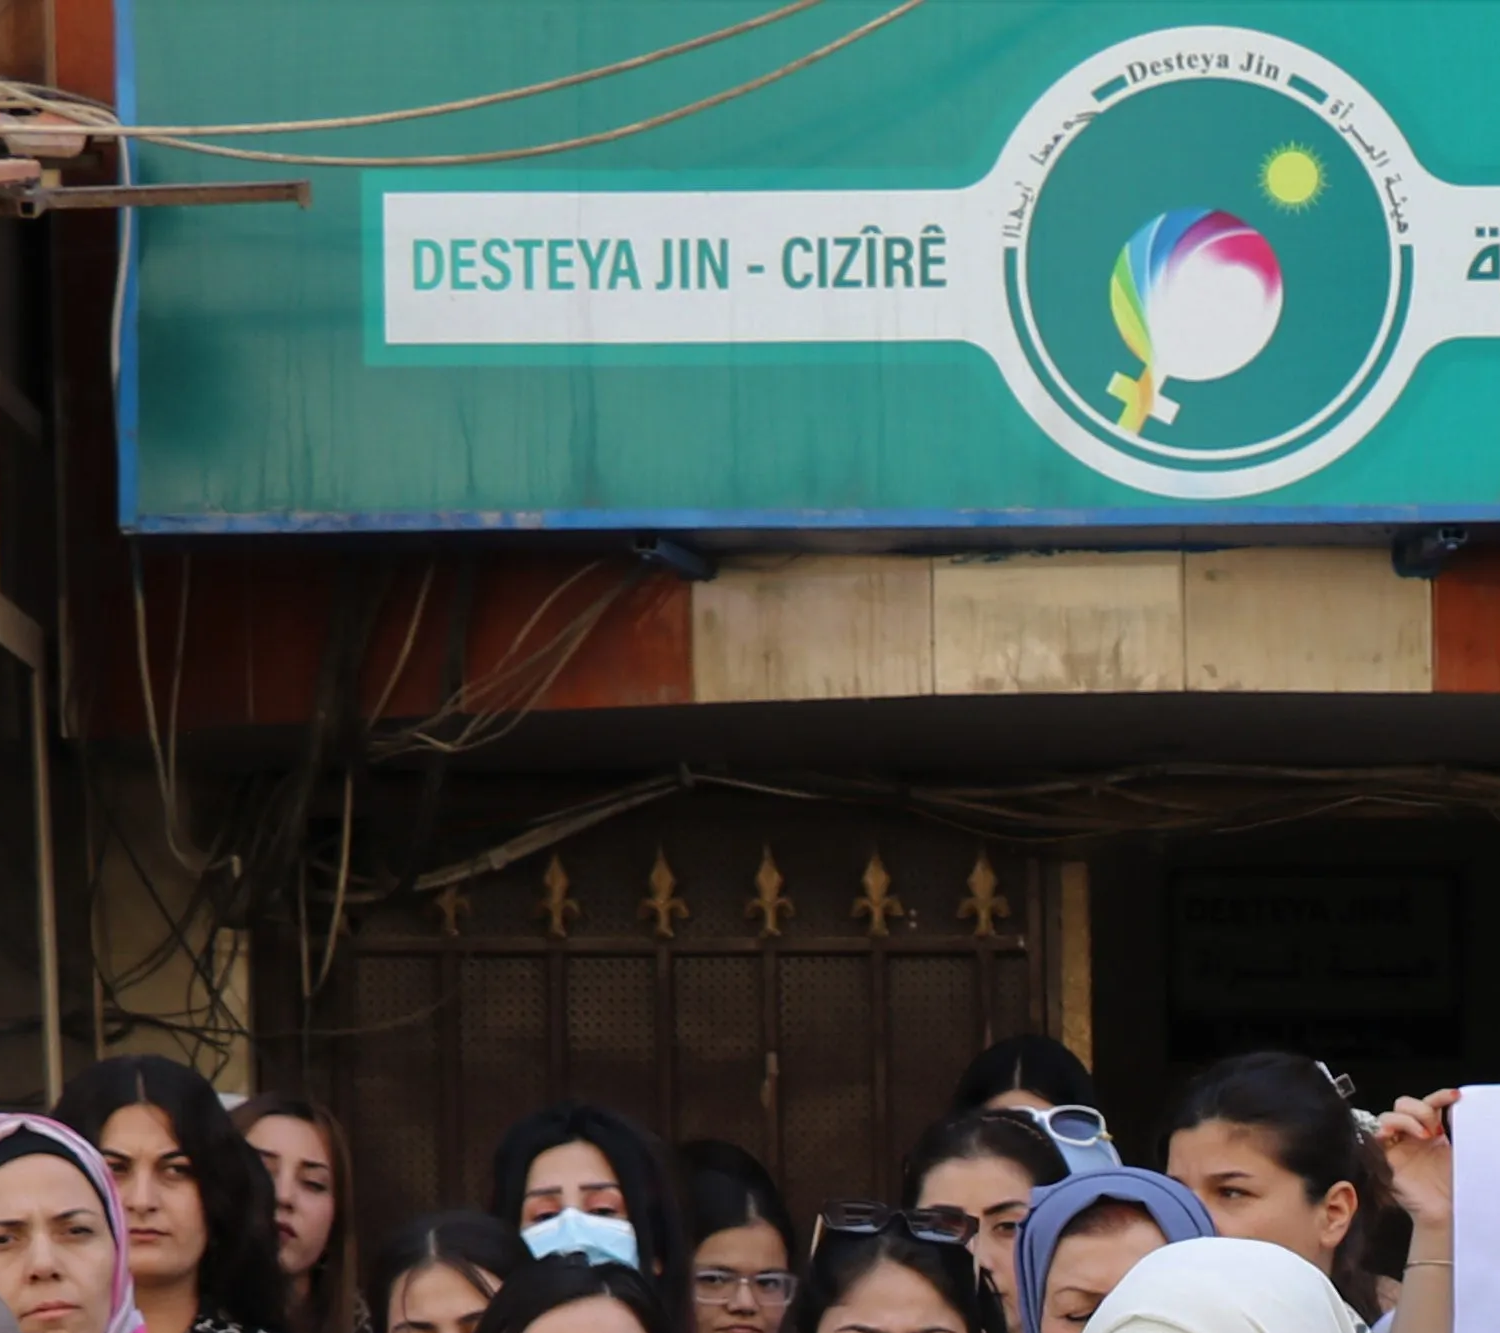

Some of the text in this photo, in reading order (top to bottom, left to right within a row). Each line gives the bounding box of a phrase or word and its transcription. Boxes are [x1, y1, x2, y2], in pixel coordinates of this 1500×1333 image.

[1126, 51, 1281, 85] Desteya Jin
[413, 238, 641, 290] DESTEYA
[655, 238, 730, 290] JIN
[782, 225, 947, 288] CIZÎRÊ
